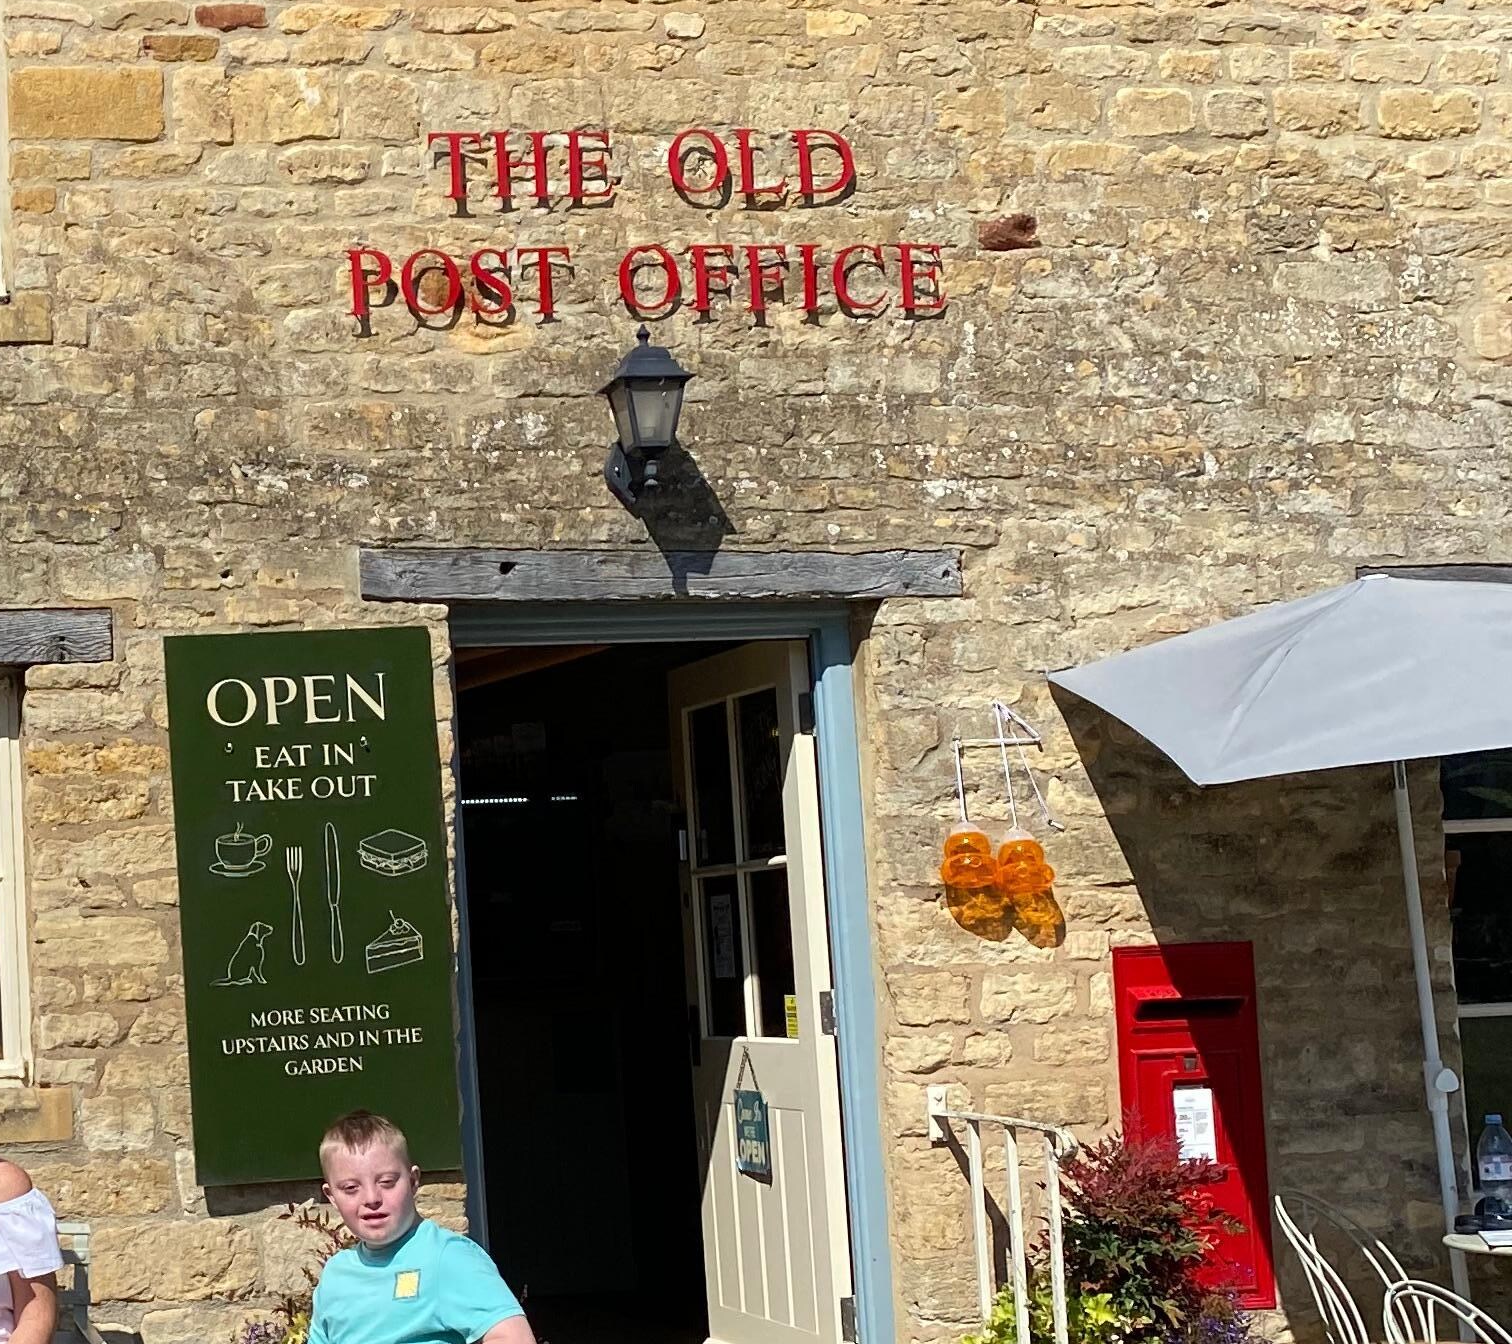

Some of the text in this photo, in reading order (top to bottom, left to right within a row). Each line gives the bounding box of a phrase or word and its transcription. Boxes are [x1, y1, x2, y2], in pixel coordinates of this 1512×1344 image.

[427, 127, 857, 201] THE OLD
[344, 242, 949, 317] POST OFFICE
[206, 672, 387, 727] OPEN
[254, 742, 355, 769] EAT IN
[225, 774, 378, 803] TAKE OUT
[250, 1003, 390, 1028] MORE SEATING
[221, 1027, 424, 1055] UPSTAIRS AND IN THE
[284, 1056, 364, 1076] GARDEN
[739, 1138, 767, 1166] OPEN
